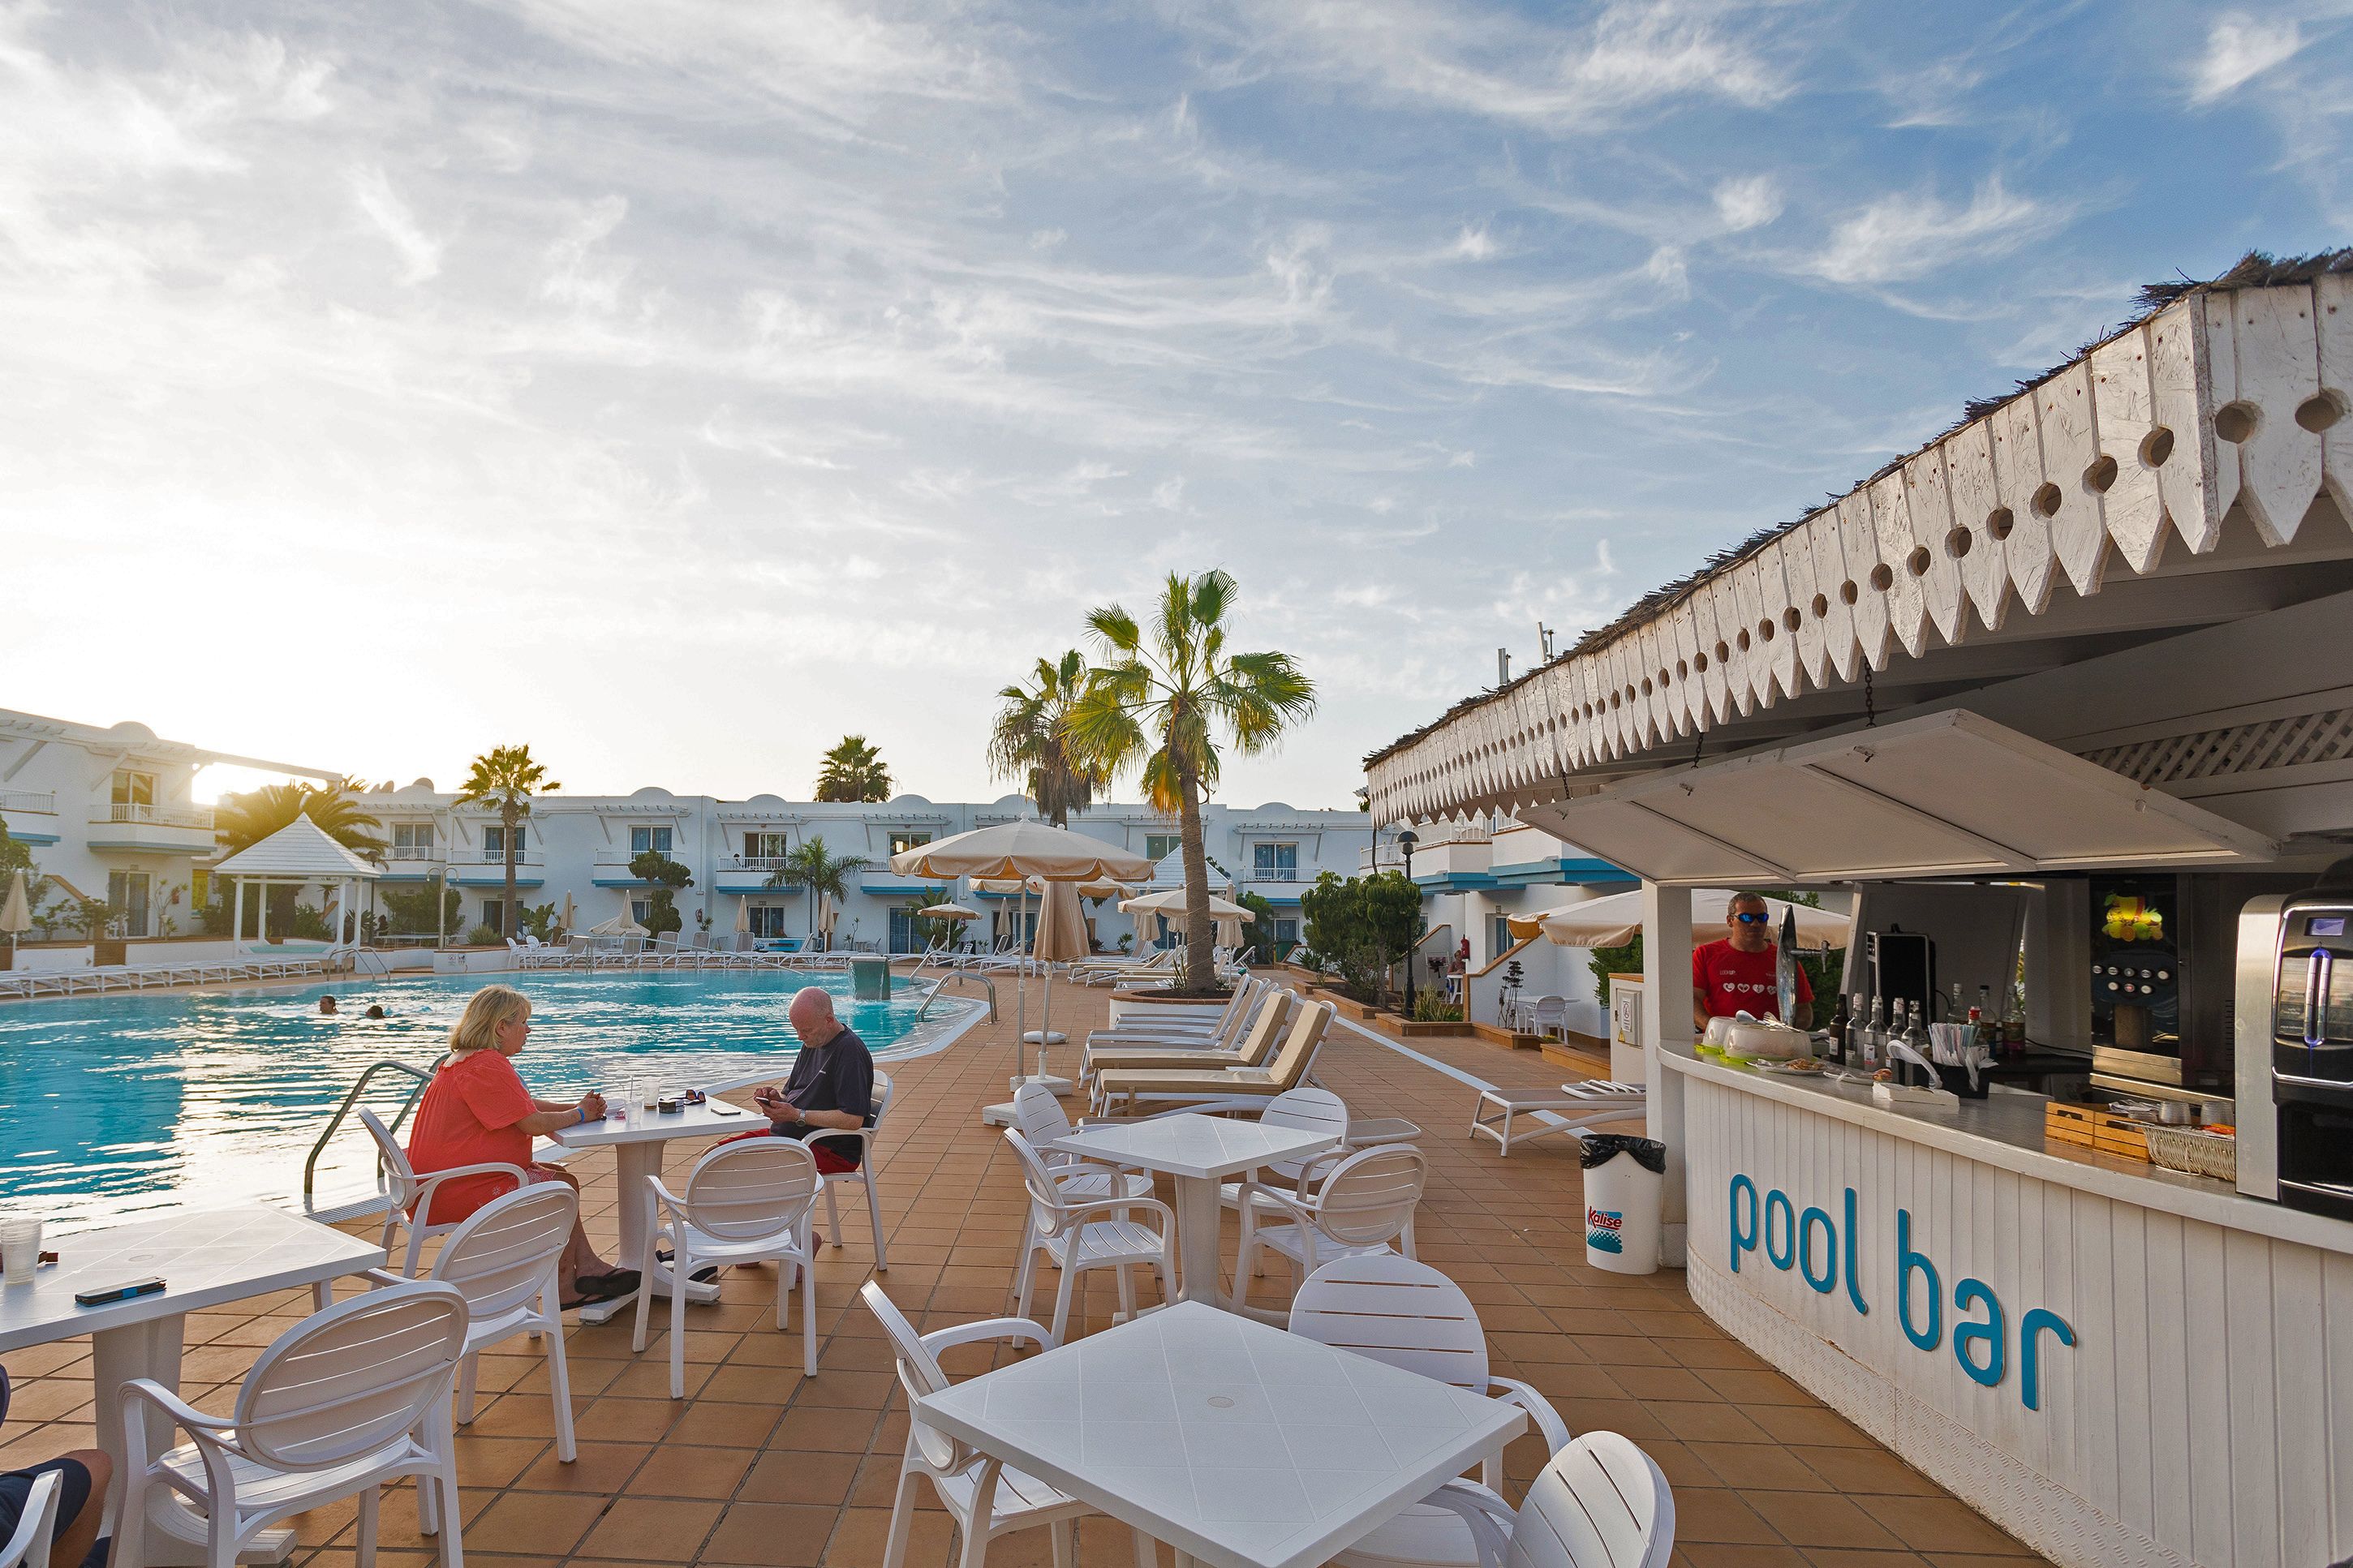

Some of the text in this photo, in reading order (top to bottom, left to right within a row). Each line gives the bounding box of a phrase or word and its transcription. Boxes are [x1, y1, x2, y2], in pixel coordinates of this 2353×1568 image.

[1588, 1206, 1623, 1229] Kalise
[1730, 1174, 2076, 1411] pool bar
